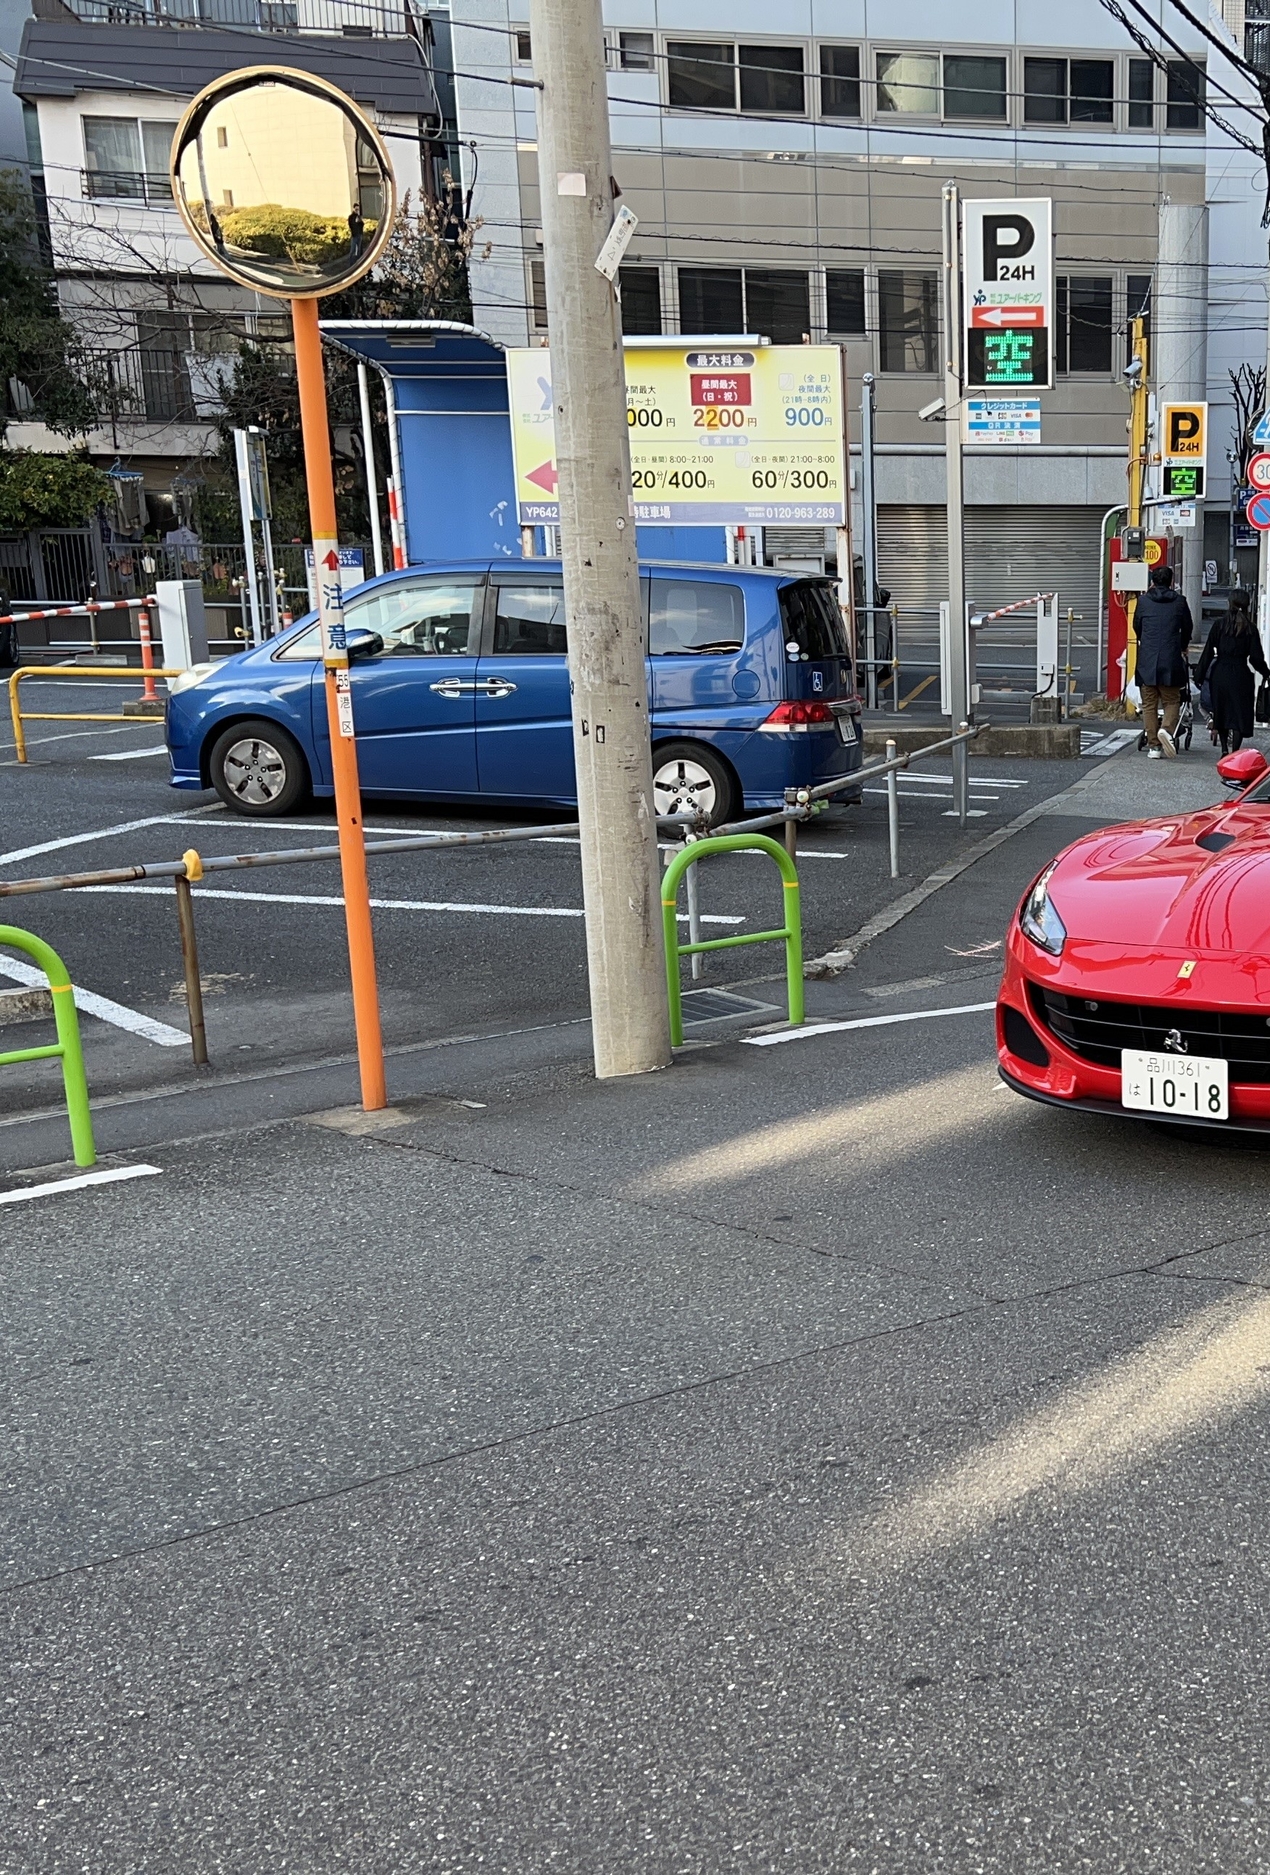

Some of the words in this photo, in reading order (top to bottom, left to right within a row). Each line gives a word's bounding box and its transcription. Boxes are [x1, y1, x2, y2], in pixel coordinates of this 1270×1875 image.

[982, 214, 1035, 281] P
[999, 265, 1035, 281] 24H
[696, 354, 744, 367] 最大料金
[985, 329, 1034, 382] 空
[701, 379, 738, 390] 昼間最大
[798, 385, 831, 394] 夜間最大
[981, 402, 1028, 410] クレジットカード
[1171, 411, 1200, 452] P
[1179, 442, 1200, 452] 24H
[526, 506, 558, 518] YP642
[766, 507, 835, 519] 0120-963-289
[323, 583, 347, 650] 注意
[1149, 1077, 1221, 1113] 10-18
